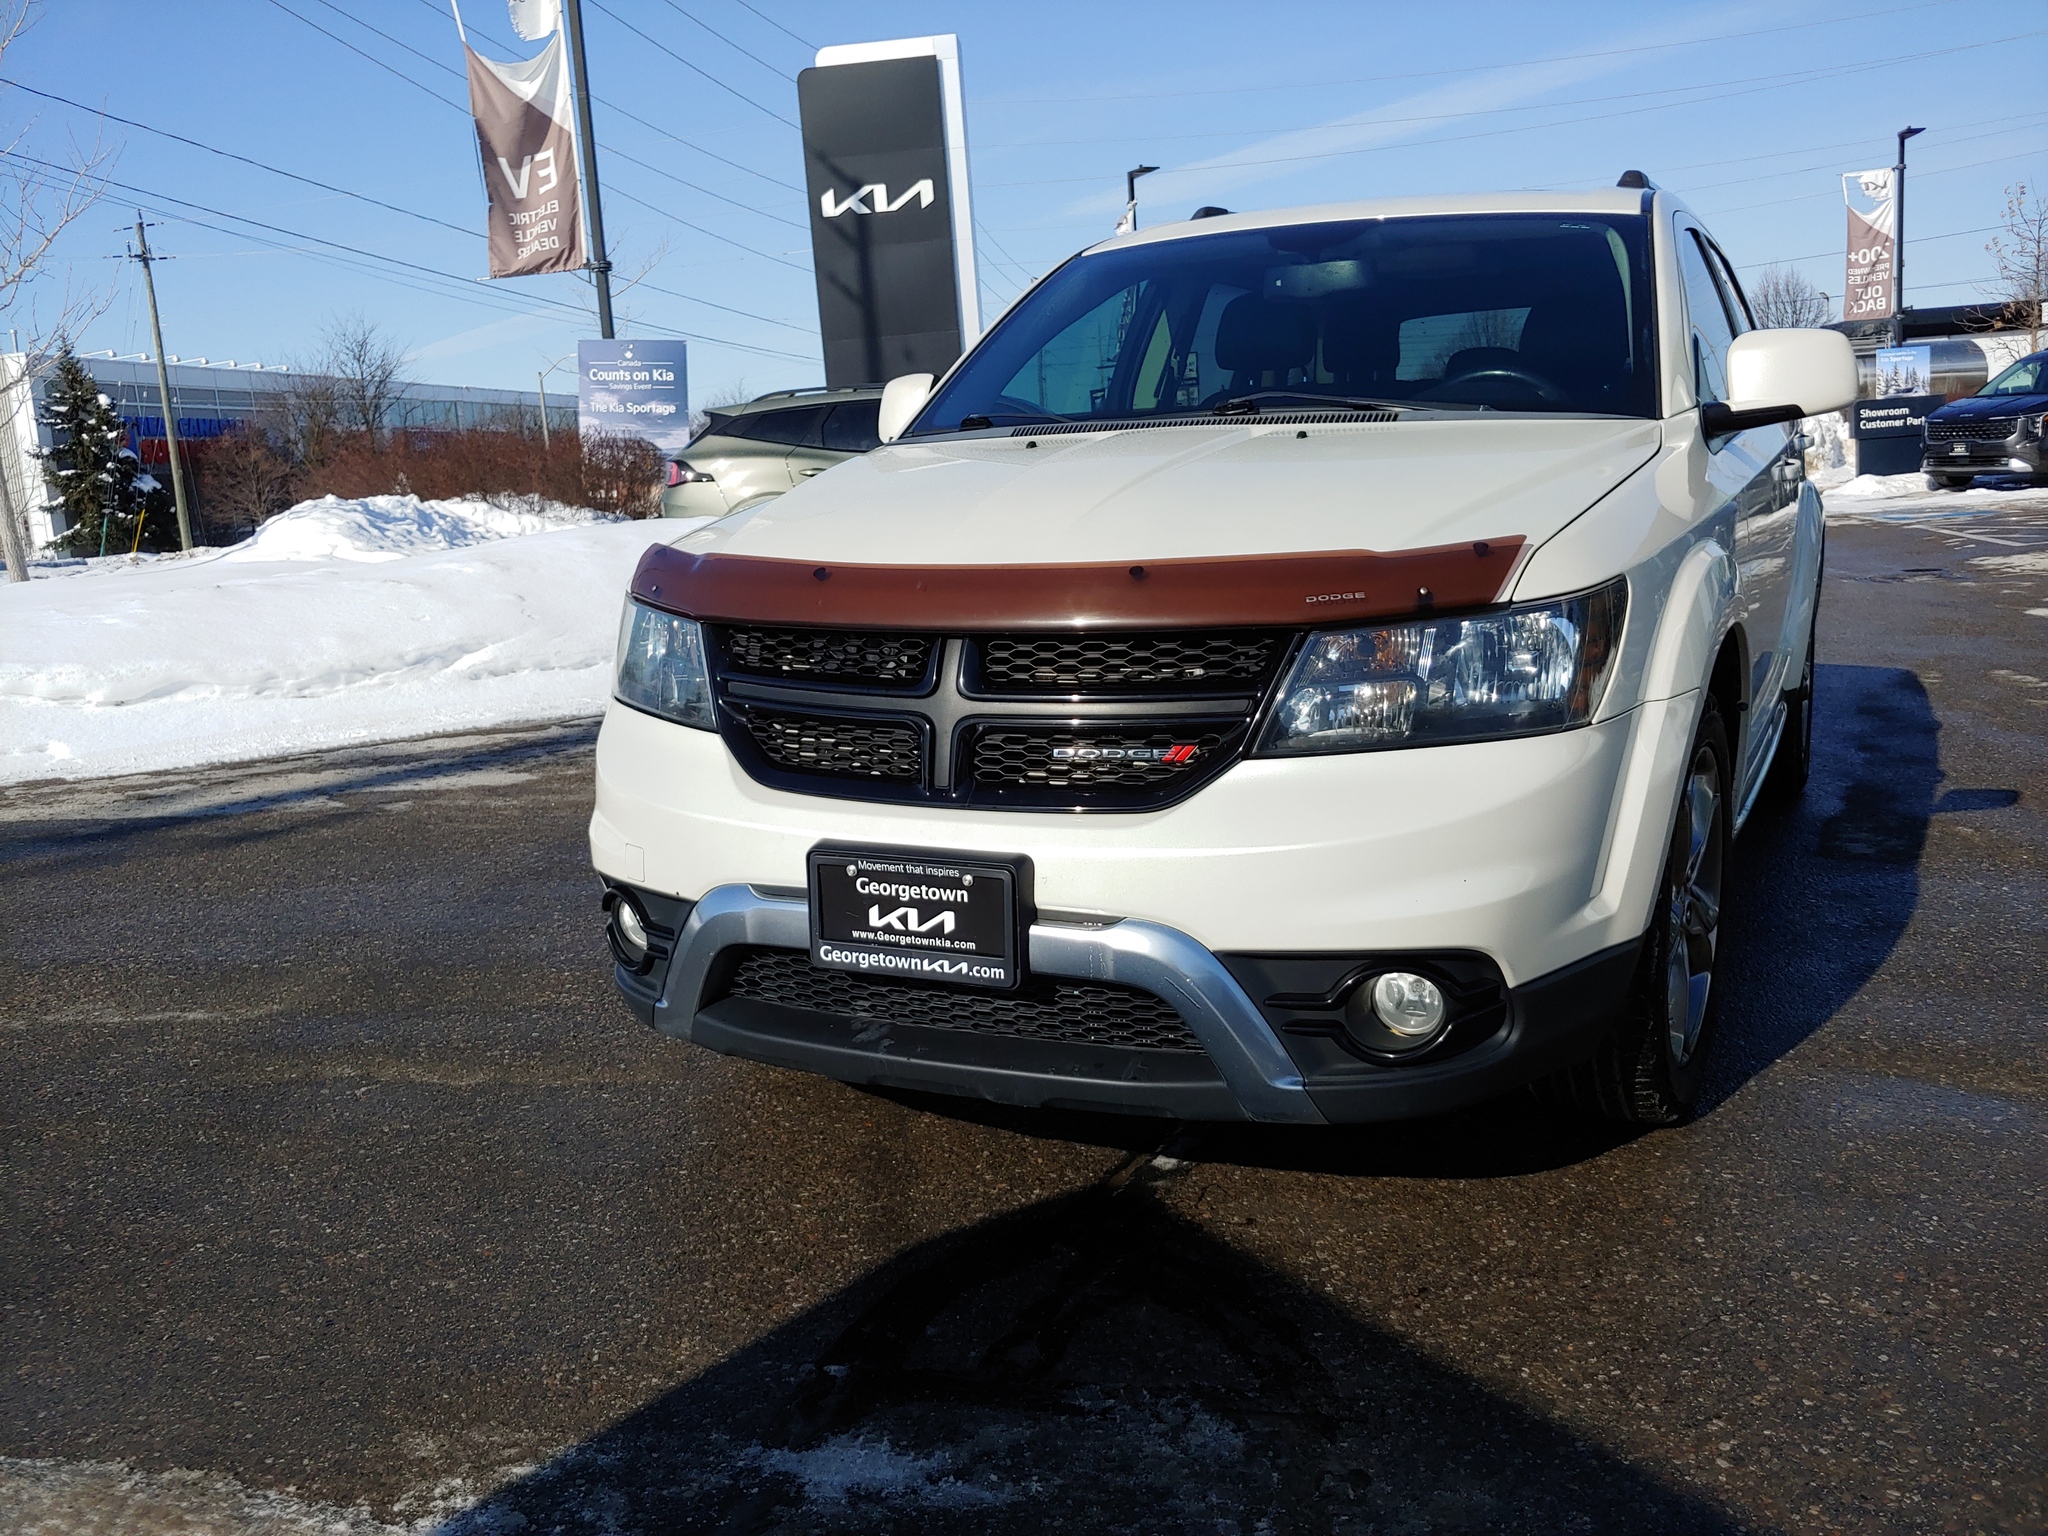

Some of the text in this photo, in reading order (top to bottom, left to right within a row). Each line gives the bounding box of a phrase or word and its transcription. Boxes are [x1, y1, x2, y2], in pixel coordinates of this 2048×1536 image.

[820, 178, 935, 218] KIA
[589, 369, 675, 381] Counts on Kia
[608, 383, 633, 391] Savings
[590, 402, 677, 415] The Kia Sportage
[1860, 408, 1909, 418] Showroom
[1860, 419, 1905, 429] Customer
[1305, 592, 1366, 603] DODGE
[1052, 748, 1176, 759] DODGE
[857, 860, 960, 877] Movement that inspires
[855, 877, 969, 903] Georgetown
[868, 903, 956, 935] KIA
[852, 929, 976, 950] www.Georgetownkia.com
